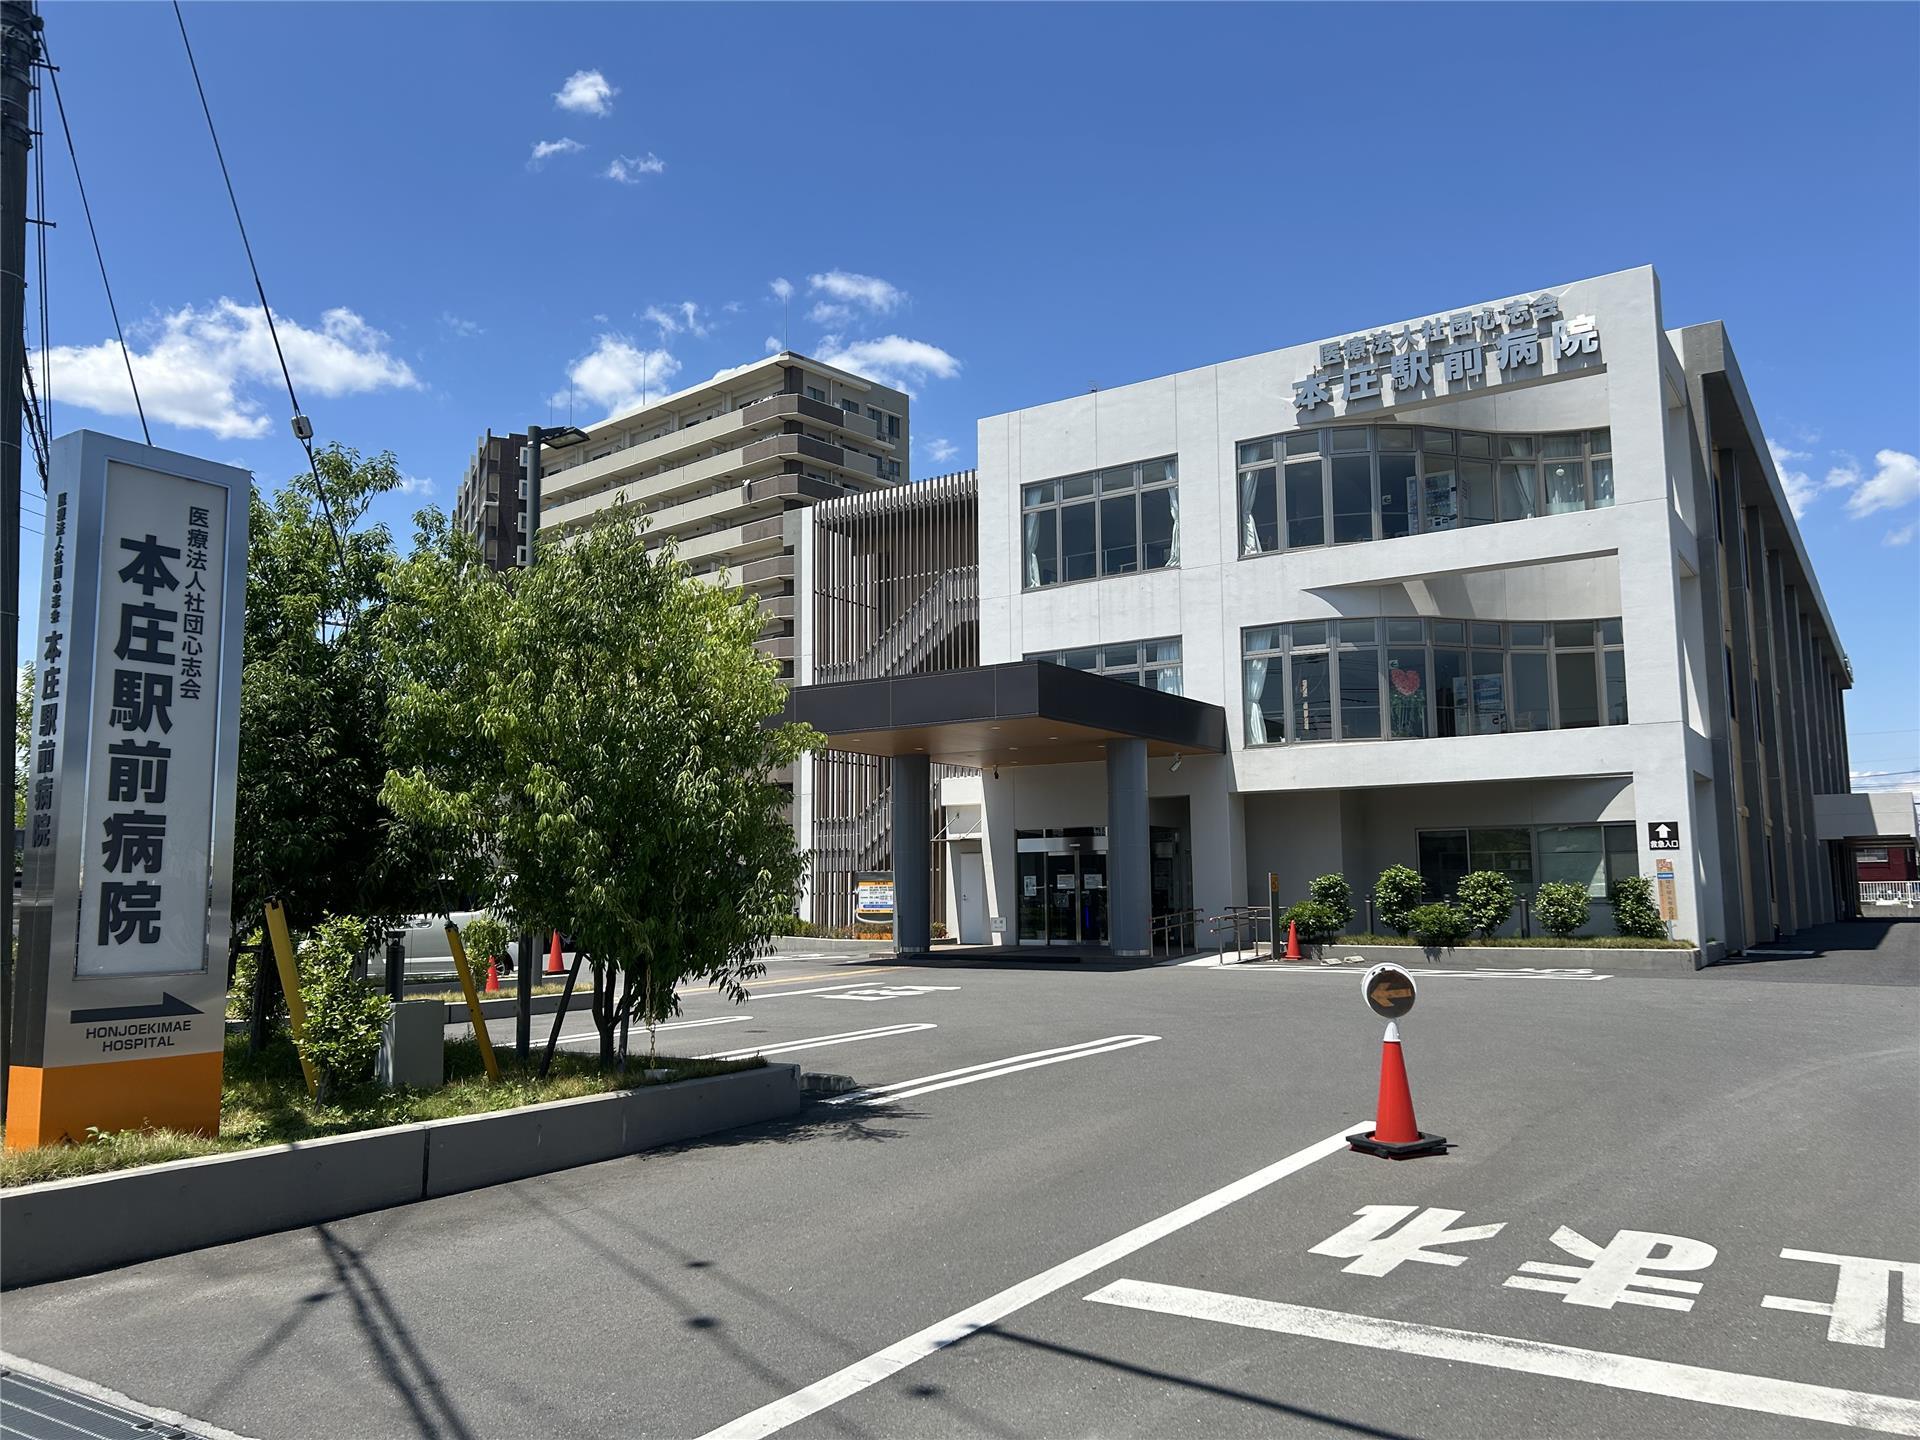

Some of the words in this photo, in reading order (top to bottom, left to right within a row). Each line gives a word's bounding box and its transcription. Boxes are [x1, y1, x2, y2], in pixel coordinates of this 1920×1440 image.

[1291, 313, 1600, 411] 本庄駅前病院
[1319, 293, 1559, 367] 医療法人社団心志会
[180, 505, 209, 700] 医療法人社団心志会
[32, 629, 63, 849] 本庄駅前病院
[98, 535, 181, 945] 本庄駅前病院
[1650, 840, 1679, 848] 救急入口
[86, 1020, 191, 1039] HONJOEKIMAE
[102, 1036, 175, 1053] HOSPITAL
